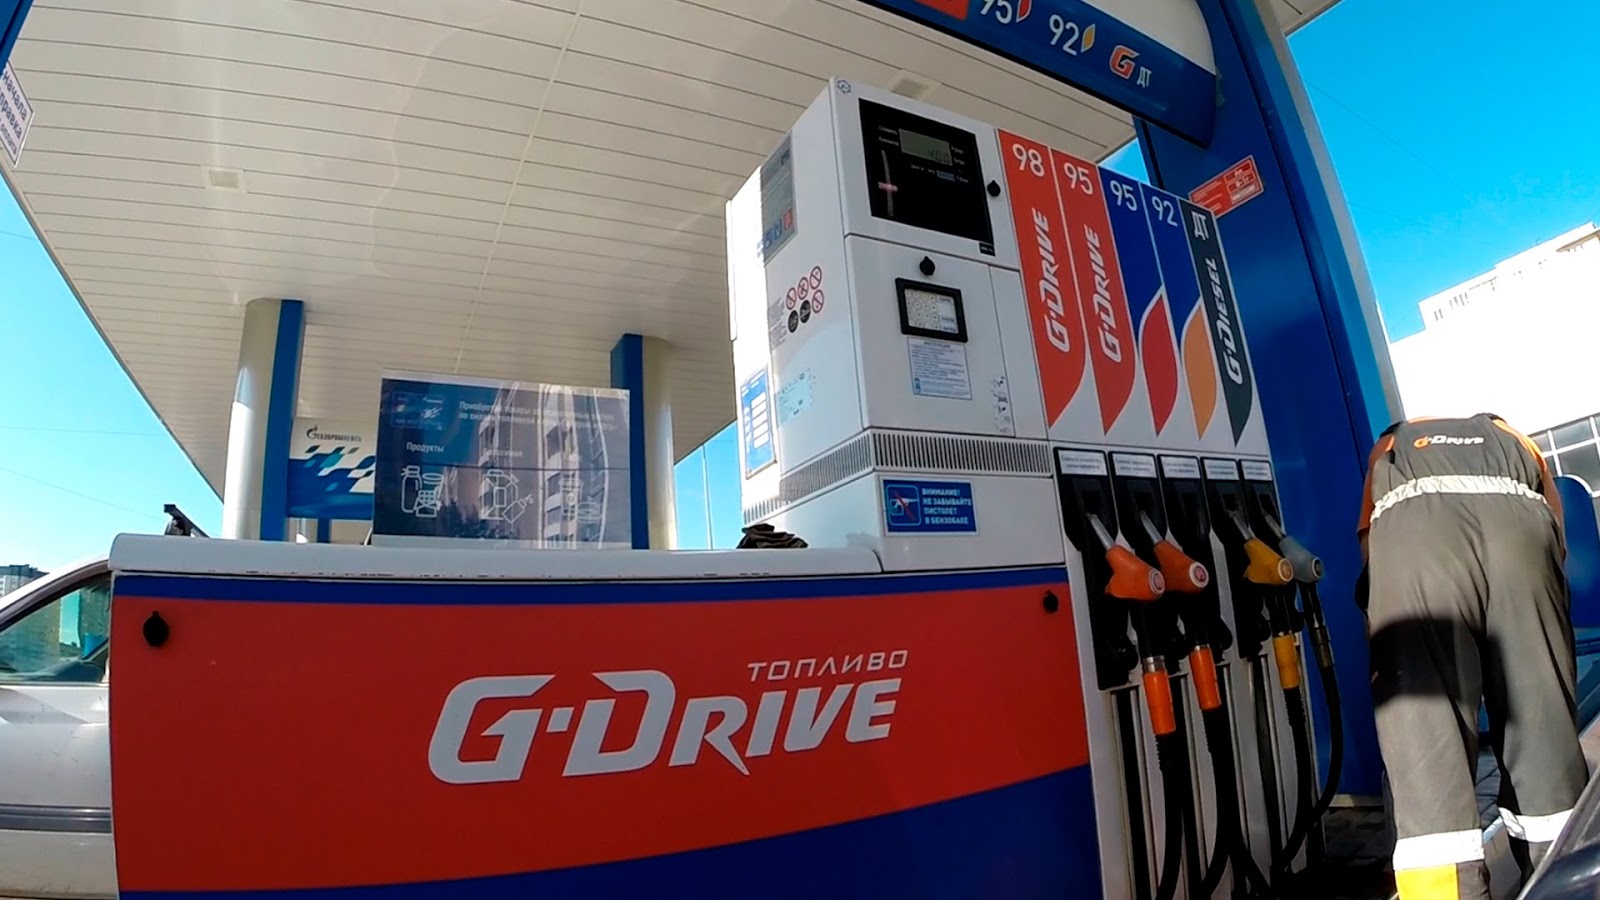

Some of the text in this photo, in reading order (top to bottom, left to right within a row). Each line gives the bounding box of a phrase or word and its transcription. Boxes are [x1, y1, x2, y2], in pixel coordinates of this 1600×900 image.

[1048, 14, 1080, 56] 92
[1136, 66, 1152, 88] ДТ
[0, 87, 22, 139] правка
[1012, 143, 1045, 178] 98
[1063, 162, 1094, 196] 95
[1110, 180, 1138, 212] 95
[1152, 196, 1178, 228] 92
[1191, 210, 1210, 241] ДТ
[406, 441, 445, 453] Продукты
[922, 488, 960, 497] ВНИМАНИЕ!
[923, 496, 971, 506] НЕ ЗАБЫВАЙТЕ
[924, 507, 957, 515] ПИСТОЛЕТ
[931, 516, 969, 525] БЕНЗОБАКЕ
[747, 650, 908, 682] ТОПЛИВО
